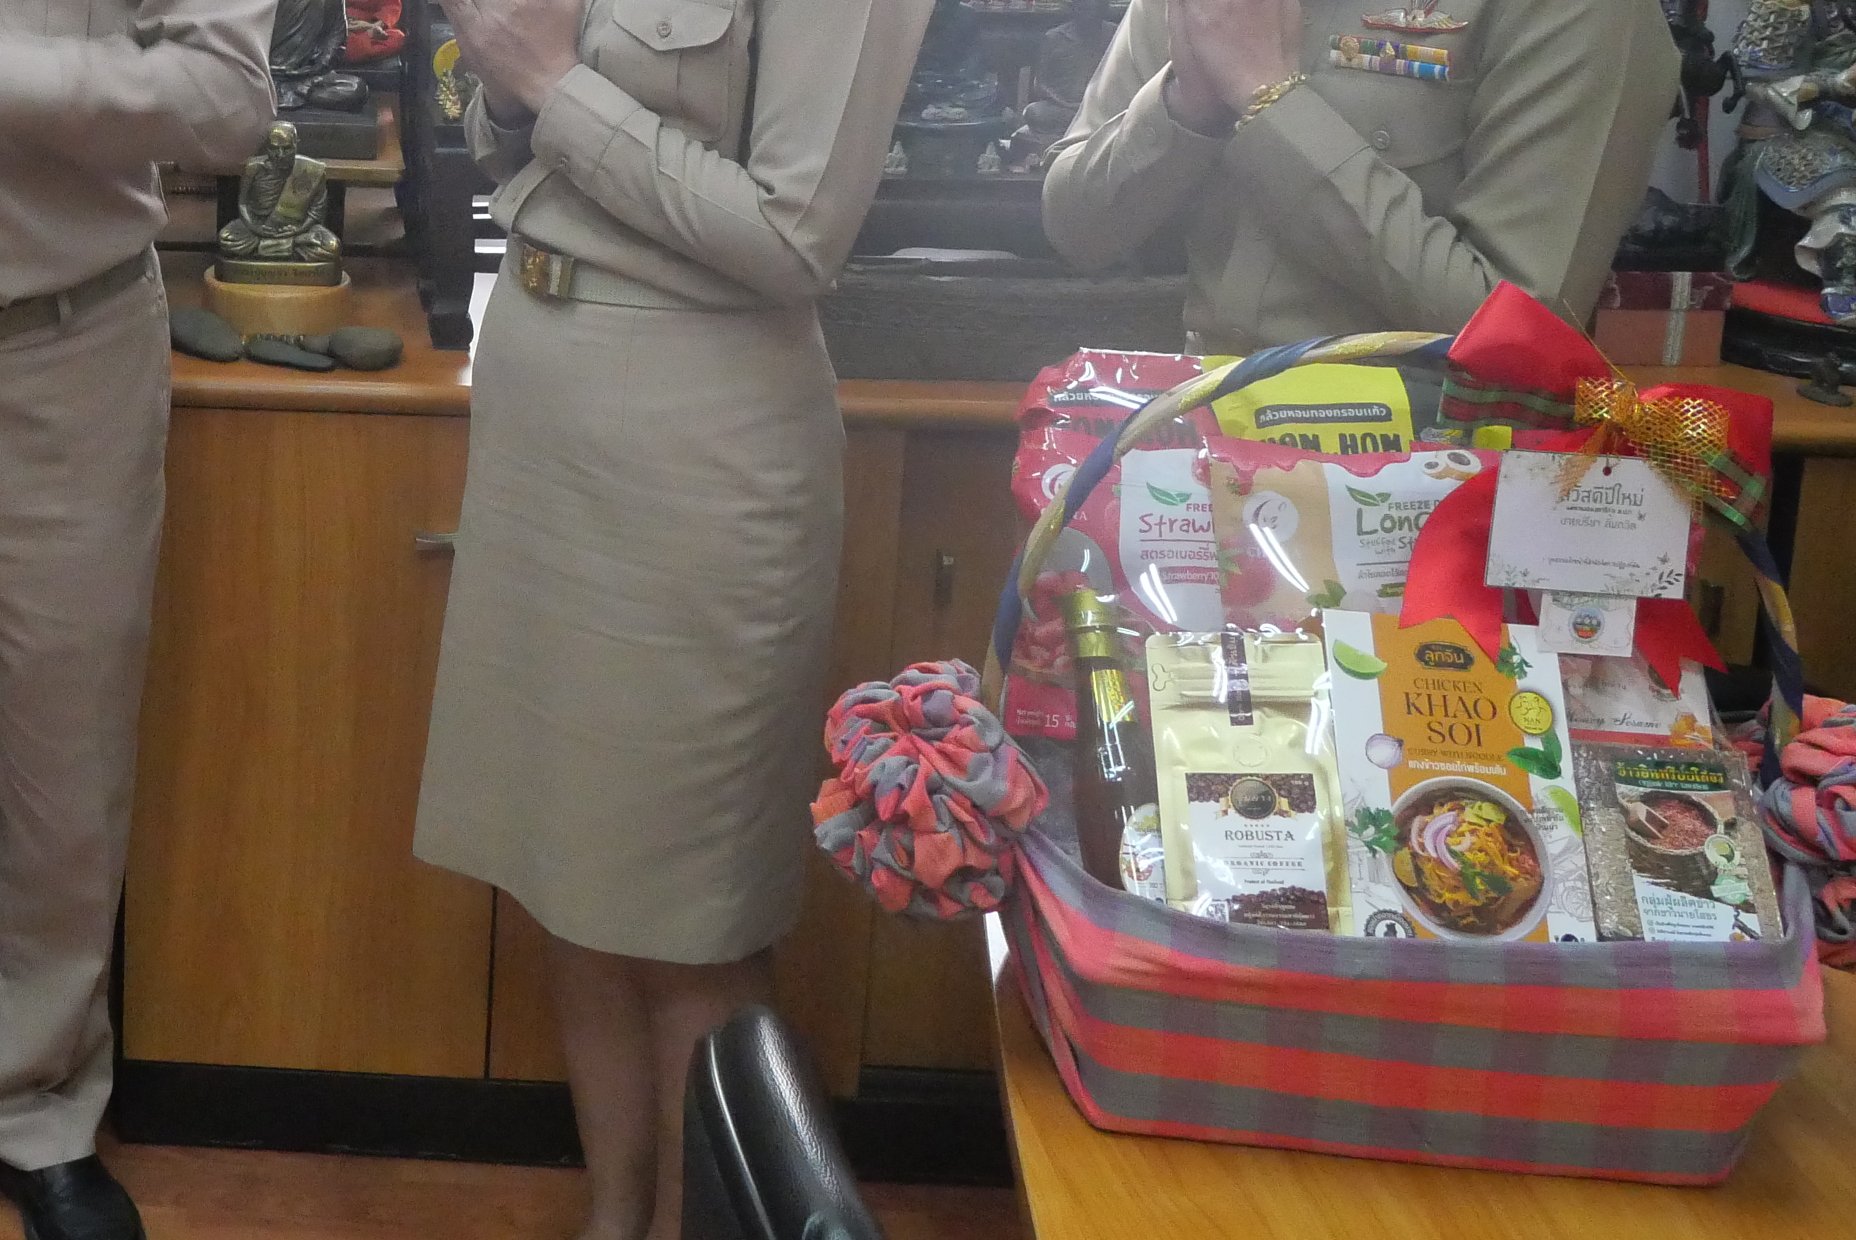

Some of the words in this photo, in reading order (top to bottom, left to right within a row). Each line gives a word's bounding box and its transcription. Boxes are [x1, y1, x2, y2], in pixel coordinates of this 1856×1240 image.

[1388, 500, 1431, 512] FREEZE
[1413, 677, 1484, 695] CHICKEN
[1403, 691, 1497, 722] KHAO
[1045, 714, 1060, 728] 15
[1426, 720, 1483, 748] SOI
[1224, 829, 1296, 842] ROBUSTA
